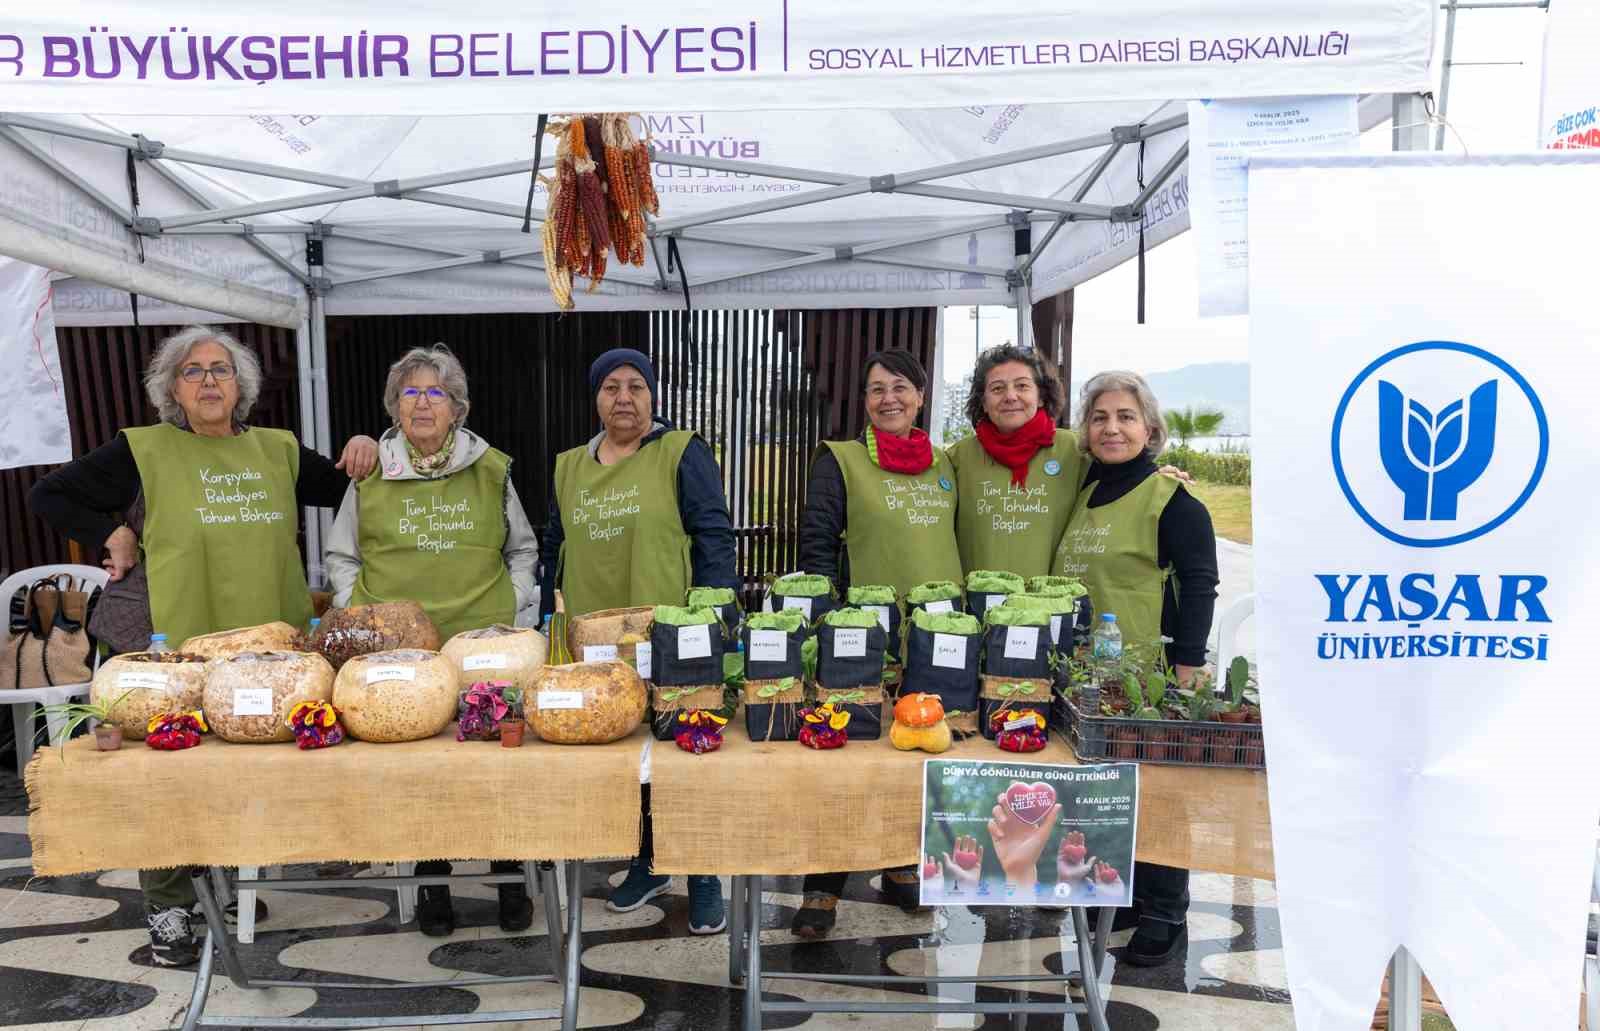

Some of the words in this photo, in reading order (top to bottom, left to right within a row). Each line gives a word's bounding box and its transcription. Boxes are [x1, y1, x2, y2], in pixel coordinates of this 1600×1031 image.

[42, 26, 409, 85] BÜYÜKŞEHİR
[430, 21, 756, 78] BELEDİYESİ
[808, 47, 913, 71] SOSYAL
[921, 44, 1071, 68] HİZMETLER
[1080, 38, 1180, 64] DAİRESİ
[1189, 31, 1350, 63] BAŞKANLIĞI
[199, 467, 262, 486] Karşıyaka
[980, 480, 1001, 497] Tüm
[1007, 479, 1048, 500] Hayat
[402, 498, 426, 516] Tüm
[431, 495, 471, 518] Hayat
[596, 501, 640, 520] Tohumla
[885, 495, 905, 510] Bir
[976, 498, 995, 515] Bir
[1000, 497, 1049, 513] Tohumla
[399, 518, 419, 535] Bir
[424, 514, 474, 531] Tohumla
[906, 508, 939, 528] Başlar
[992, 513, 1032, 534] Başlar
[588, 521, 625, 541] Başlar
[416, 533, 456, 554] Başlar
[1313, 572, 1553, 628] YAŞAR
[1316, 632, 1550, 661] ÜNİVERSİTESİ
[943, 765, 979, 777] DÜNYA
[980, 767, 1043, 780] GÖNÜLLÜLER
[1046, 769, 1075, 782] GÜNÜ
[1075, 767, 1120, 782] ETKİNLİĞİ
[1081, 796, 1111, 805] ARALIK
